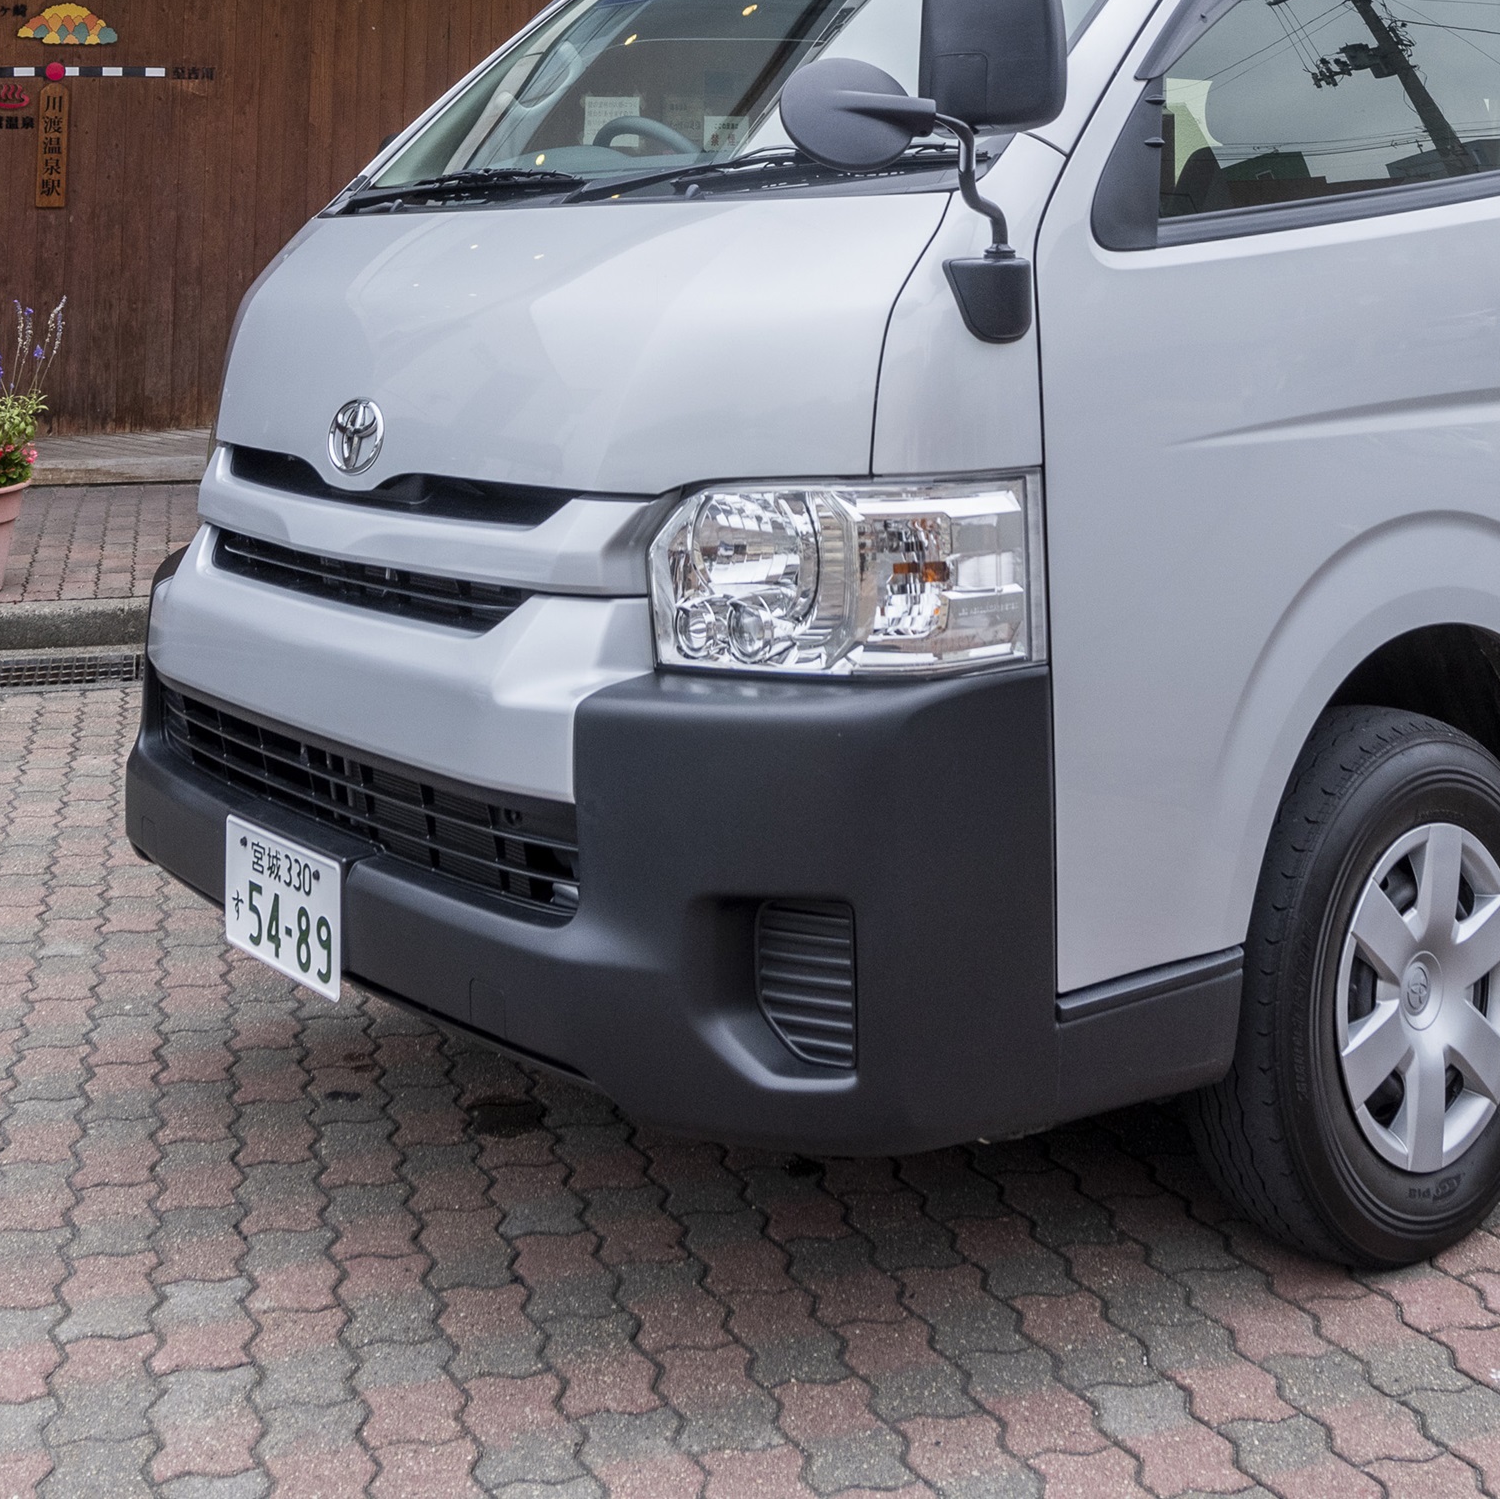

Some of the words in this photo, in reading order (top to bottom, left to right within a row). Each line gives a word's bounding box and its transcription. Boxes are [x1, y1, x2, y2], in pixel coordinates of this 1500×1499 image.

[41, 95, 63, 196] 川渡温泉駅
[248, 879, 332, 984] 54-89
